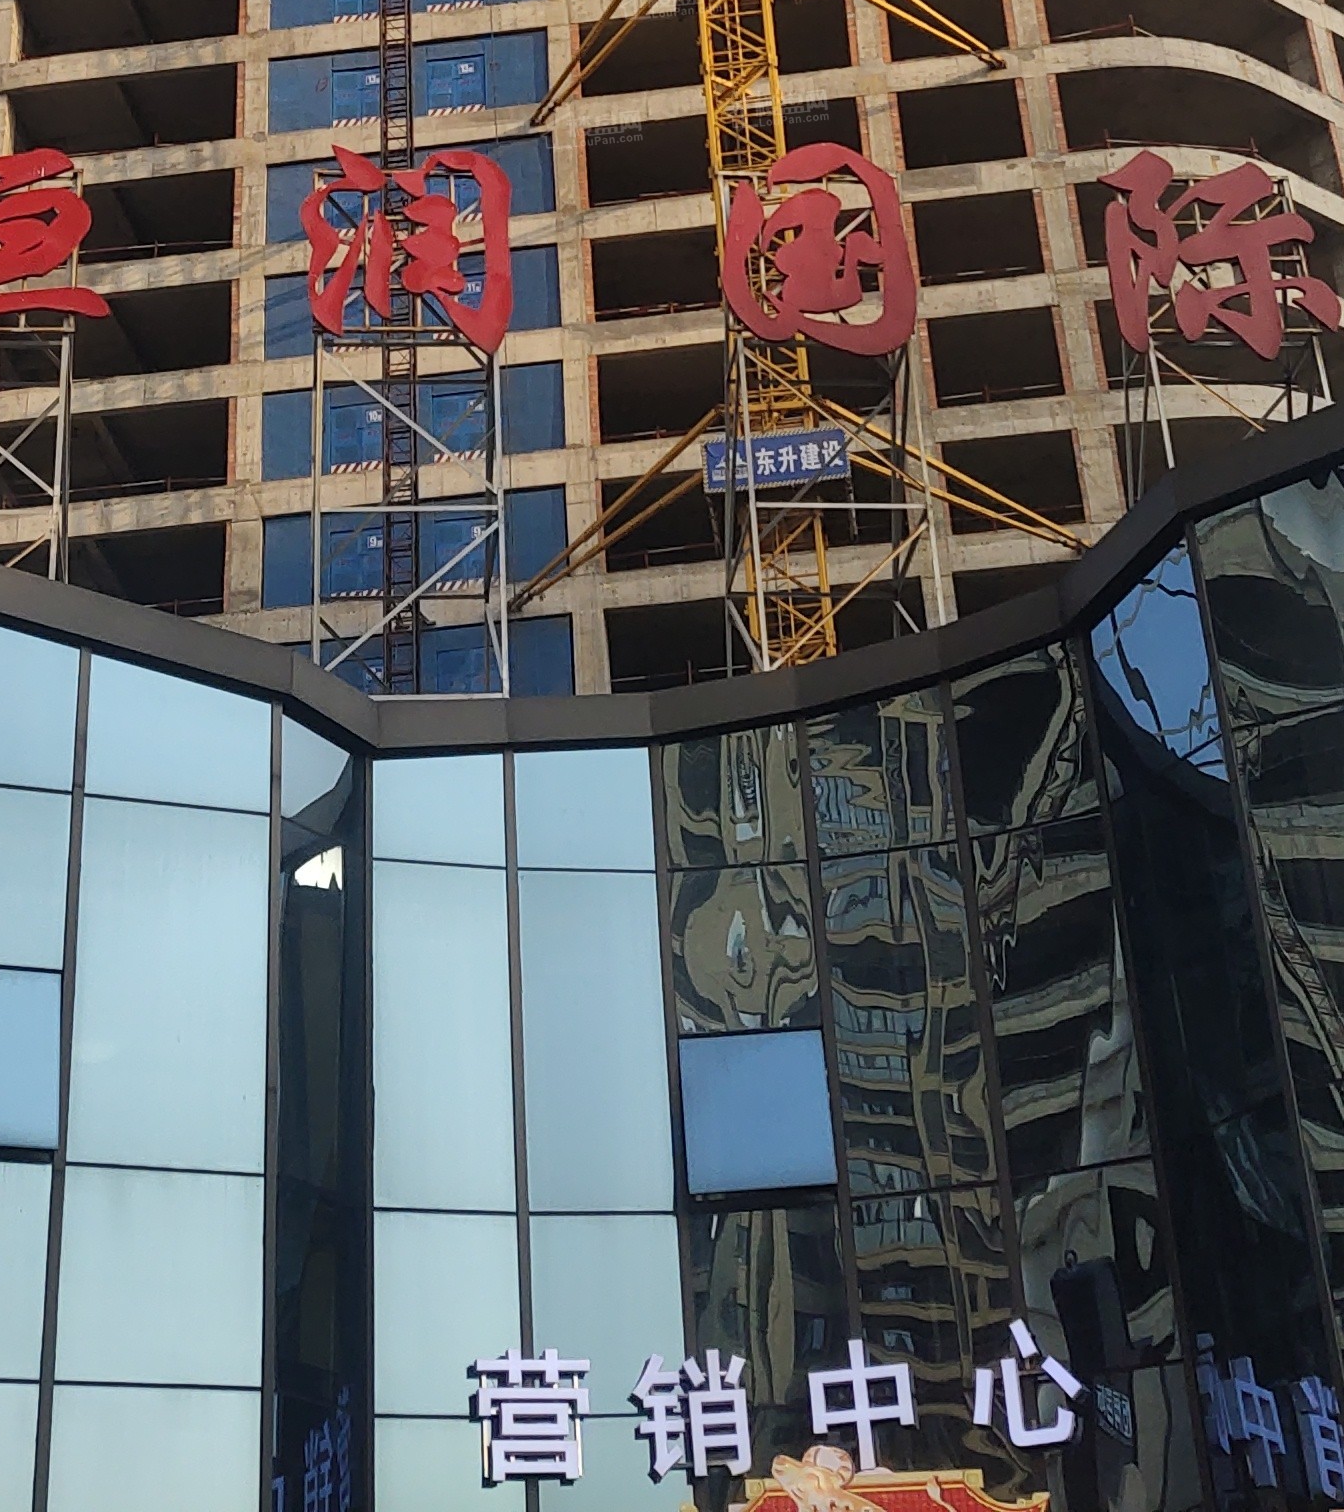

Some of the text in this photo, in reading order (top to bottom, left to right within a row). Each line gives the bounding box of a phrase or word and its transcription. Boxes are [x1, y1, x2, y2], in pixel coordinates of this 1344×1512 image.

[755, 440, 844, 476] 东升建设
[474, 1319, 1085, 1481] 营销中心
